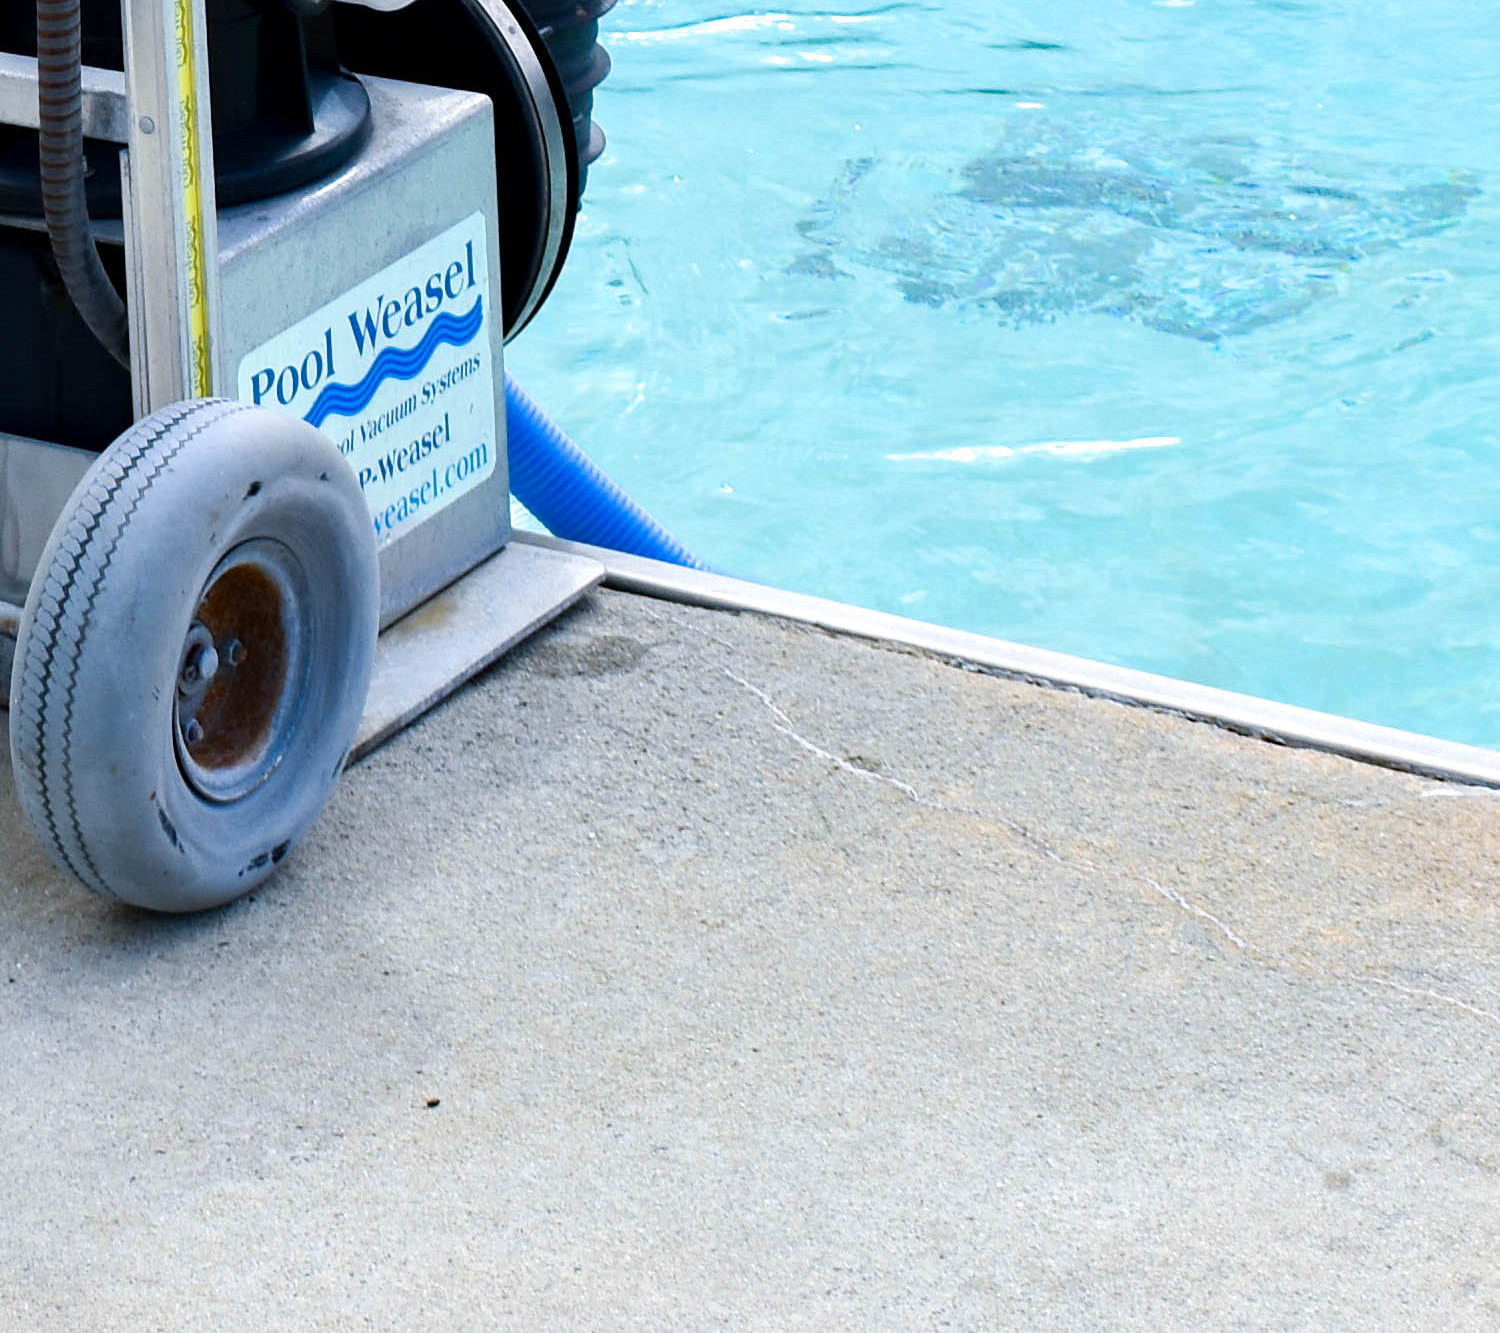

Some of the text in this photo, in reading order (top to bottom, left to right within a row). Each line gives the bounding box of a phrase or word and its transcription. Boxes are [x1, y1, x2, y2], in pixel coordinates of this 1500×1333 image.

[251, 328, 336, 405] Pool
[347, 240, 477, 357] Weasel
[336, 352, 482, 459] ol Vacuum Systems
